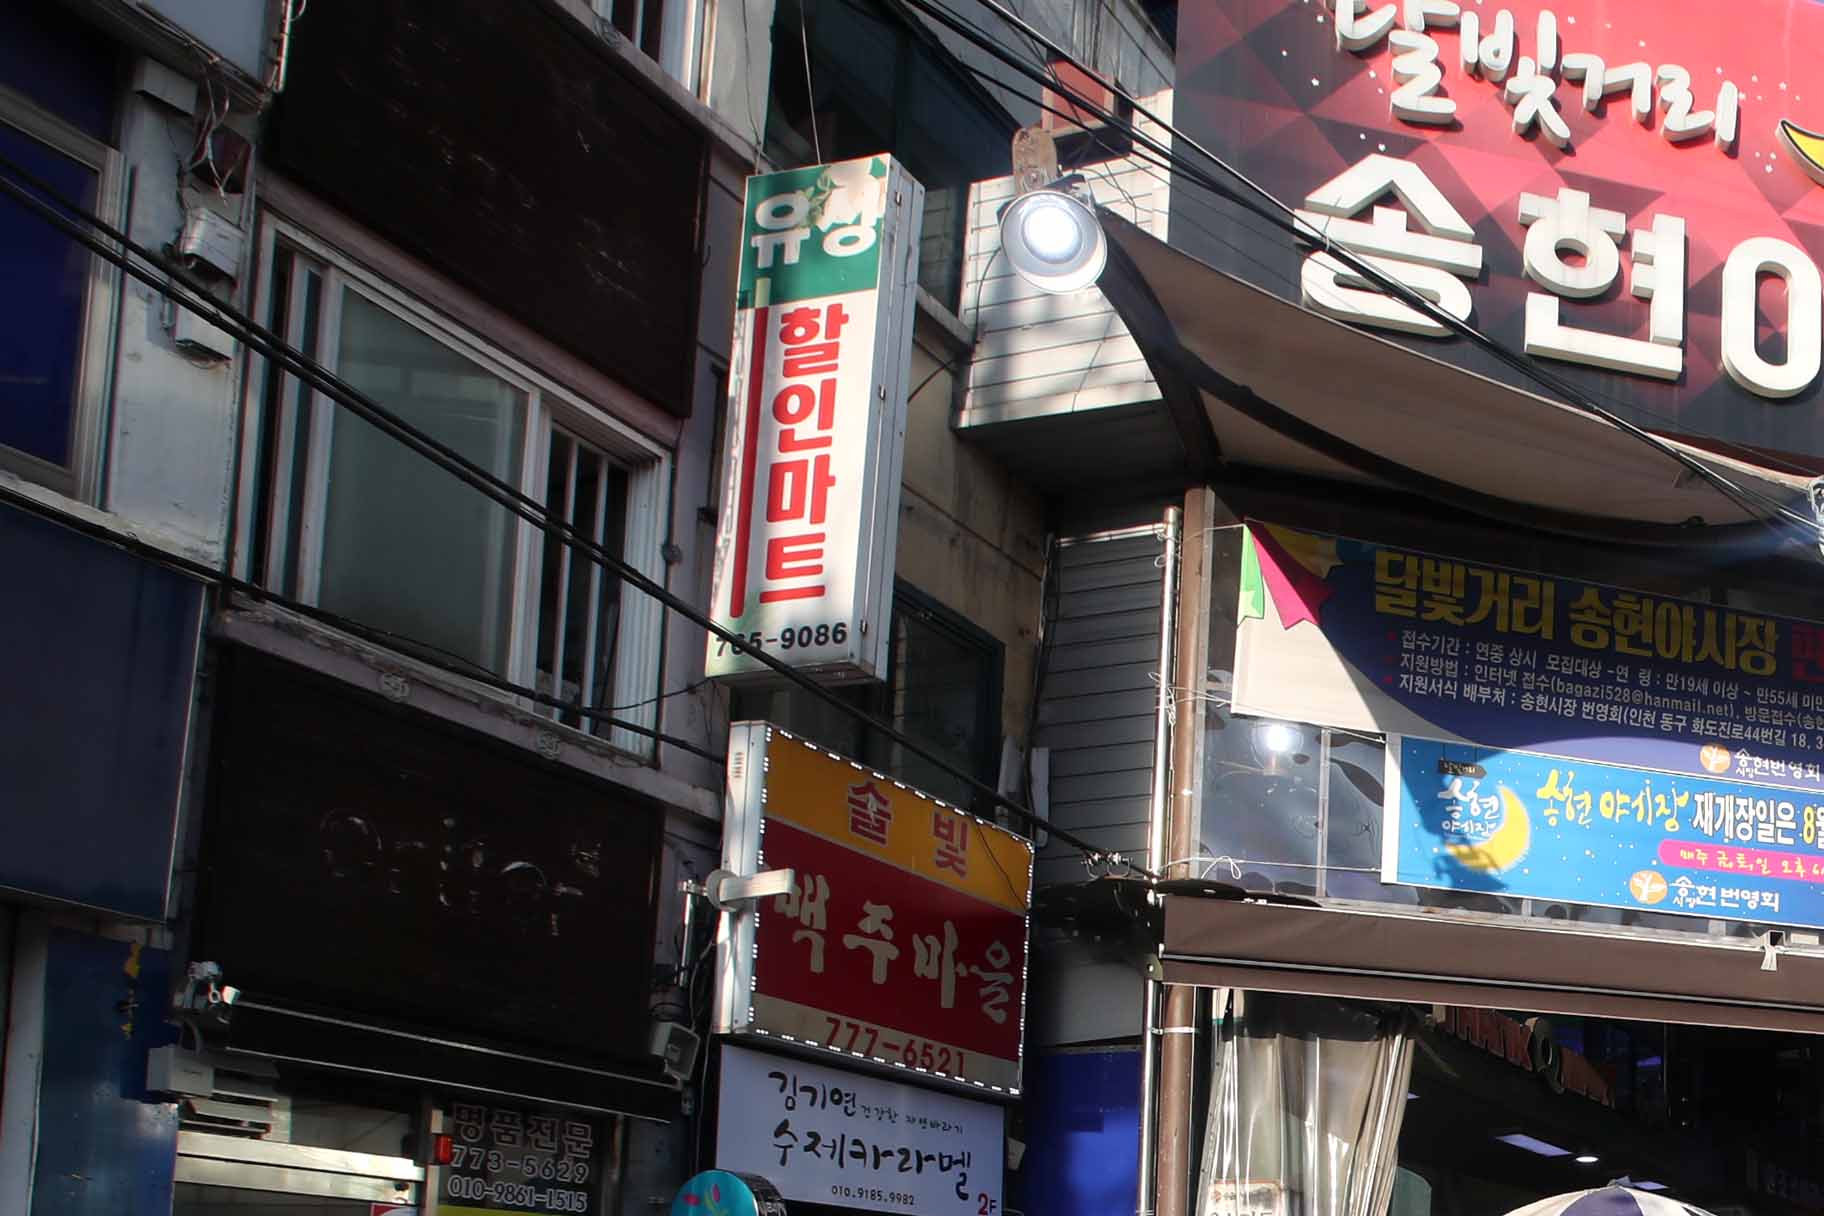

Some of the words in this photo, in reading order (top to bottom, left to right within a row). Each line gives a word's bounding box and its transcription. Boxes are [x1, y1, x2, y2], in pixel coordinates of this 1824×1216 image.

[1333, 0, 1740, 151] 달빛거리
[760, 304, 848, 603] 할인마트
[715, 622, 848, 657] 765-9086
[1375, 550, 1556, 640] 달빛거리
[1568, 587, 1780, 677] 송현야시장
[1399, 653, 1460, 679] 지원방법
[1473, 662, 1518, 688] 인터넷
[1401, 630, 1461, 657] 접수기간
[1476, 641, 1504, 665] 연중
[1508, 649, 1538, 669] 상시
[1546, 653, 1602, 679] 모집대상
[1665, 672, 1710, 698] 만19세
[1713, 679, 1739, 700] 이상
[1756, 687, 1799, 708] 만55세
[1399, 673, 1458, 700] 지원서식
[1462, 681, 1507, 708] 배부처
[1520, 691, 1578, 718] 송현시장
[1659, 711, 1688, 734] 동구
[1691, 716, 1788, 749] 화도진로44번길
[1437, 778, 1500, 820] 송현
[1536, 768, 1593, 828] 송현
[1600, 779, 1690, 832] 야시장
[1692, 791, 1797, 845] 재개장일은
[1680, 848, 1709, 866] 매주
[1781, 857, 1806, 879] 오후
[773, 873, 1014, 1025] 맥주마을
[825, 1016, 968, 1079] 777-6521
[768, 1070, 857, 1117] 김기연
[451, 1145, 590, 1184] 773-5629
[773, 1118, 972, 1201] 수제카라멜
[448, 1174, 588, 1213] 010-9861-1515
[977, 1192, 998, 1216] 2F
